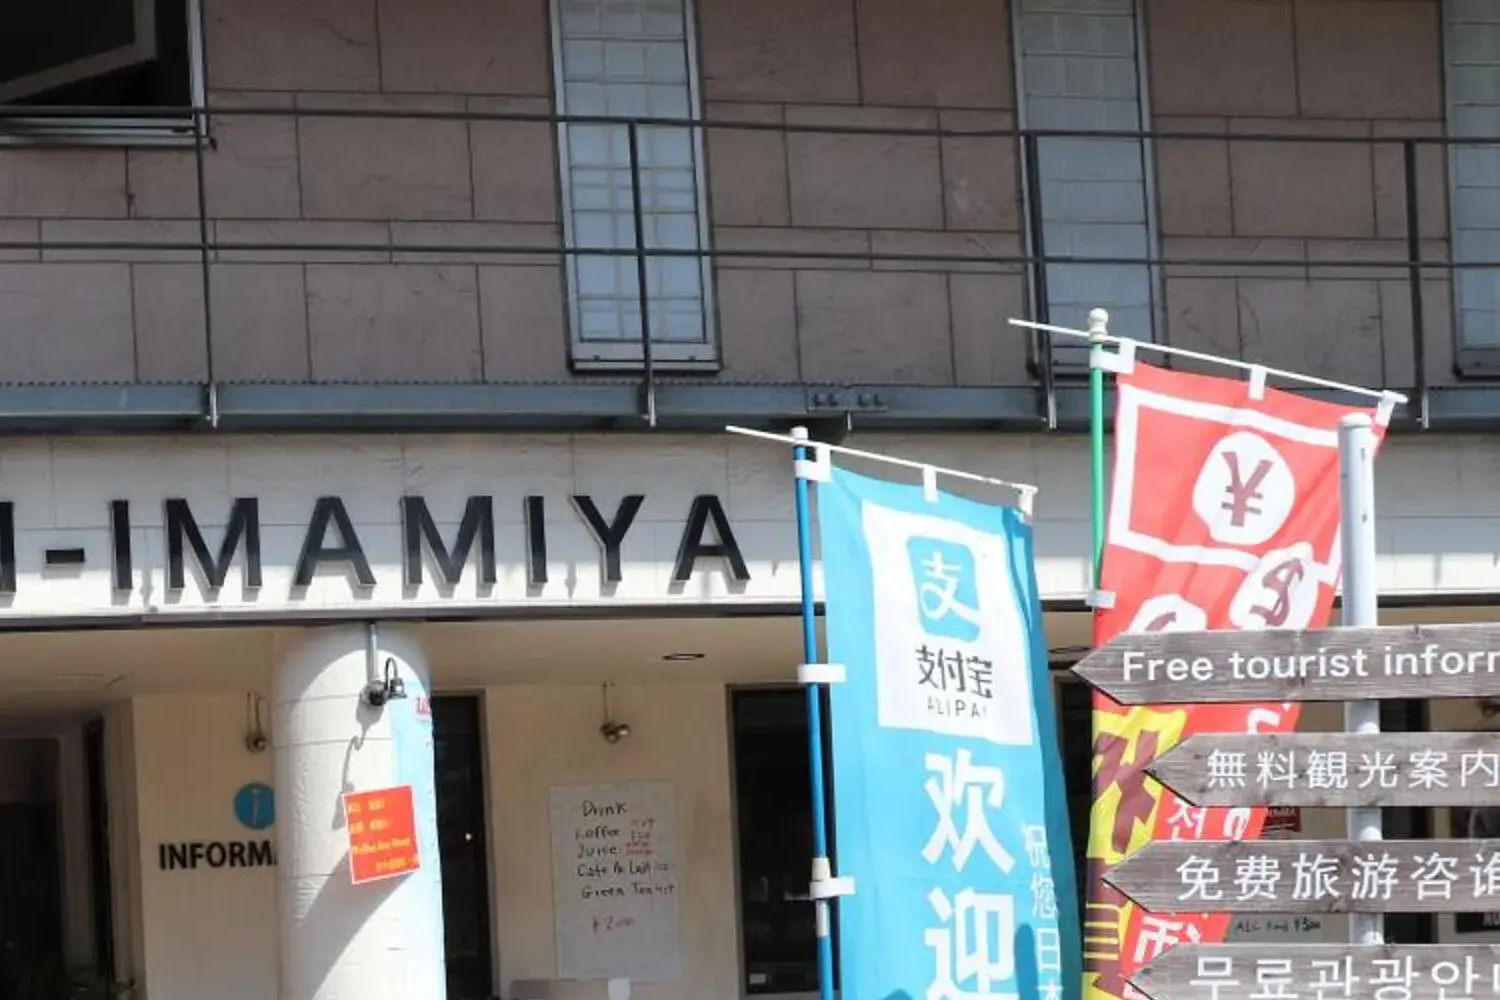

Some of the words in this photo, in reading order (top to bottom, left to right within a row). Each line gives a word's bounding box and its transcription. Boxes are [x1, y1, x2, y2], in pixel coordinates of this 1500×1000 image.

[914, 644, 994, 699] 支付宝
[1123, 651, 1214, 681] Free
[1229, 646, 1368, 679] tourist
[1207, 747, 1500, 791] 無料観光案内
[159, 841, 277, 870] INFORM
[1175, 851, 1500, 901] 免费旅游咨询
